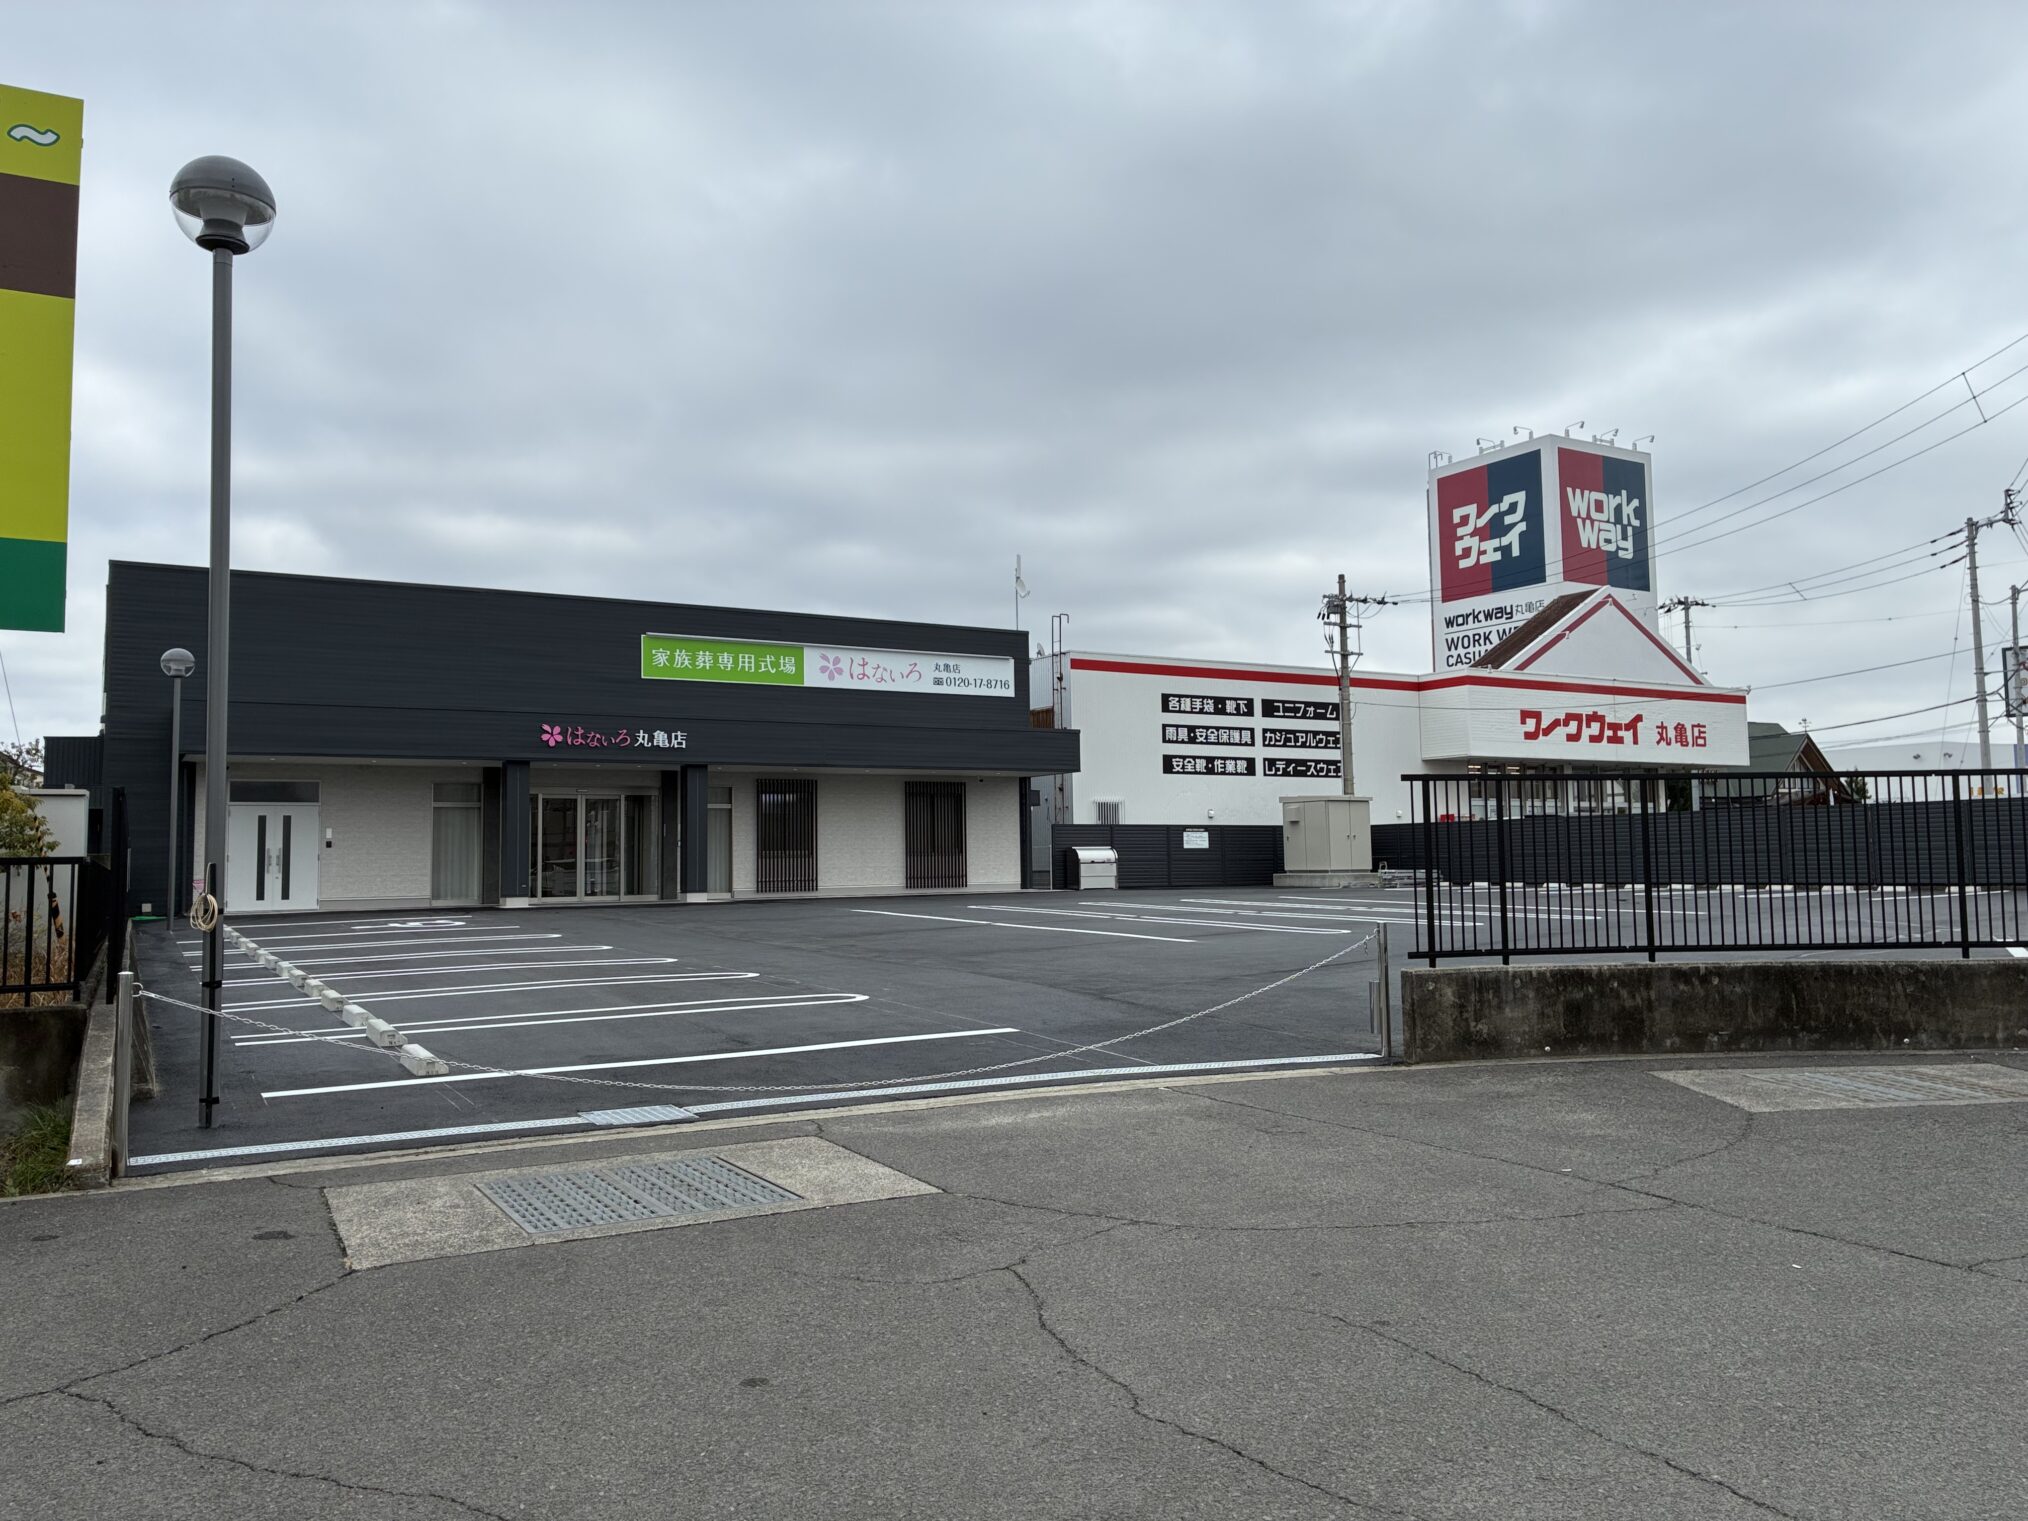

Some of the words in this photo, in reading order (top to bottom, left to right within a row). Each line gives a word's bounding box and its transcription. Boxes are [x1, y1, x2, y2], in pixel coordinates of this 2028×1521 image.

[1566, 486, 1641, 527] work
[1455, 521, 1527, 569] ウェイ
[1577, 517, 1634, 560] way
[1446, 630, 1494, 652] WORK
[651, 648, 797, 675] 家族葬専用式場
[849, 656, 923, 683] はないろ
[934, 662, 961, 674] 丸亀店
[945, 676, 1010, 690] 0120-17-8716
[1168, 696, 1248, 714] 各種手袋・靴下
[1273, 702, 1337, 718] ユニフォーム
[634, 729, 688, 749] 丸亀店
[1165, 726, 1252, 744] 雨具・安全保護具
[1520, 709, 1643, 746] ワークウェイ
[1655, 721, 1707, 748] 丸亀店
[1171, 757, 1248, 774] 安全靴・作業靴
